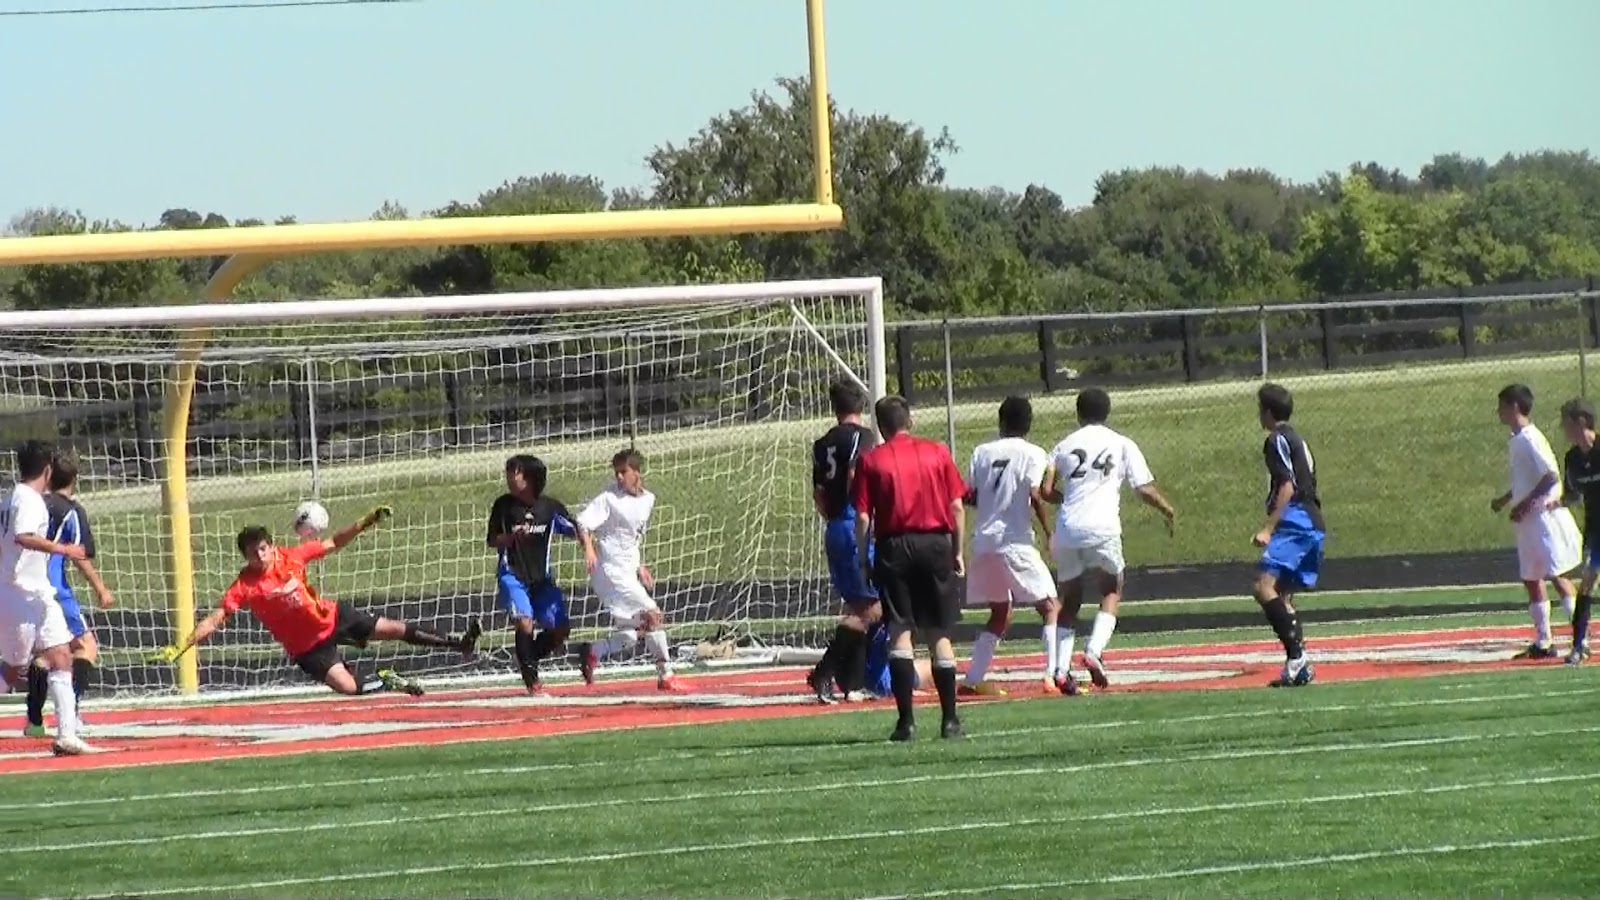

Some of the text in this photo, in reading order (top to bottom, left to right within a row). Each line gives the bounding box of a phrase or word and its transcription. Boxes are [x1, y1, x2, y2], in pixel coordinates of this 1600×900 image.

[826, 446, 837, 479] 5
[992, 459, 1011, 489] 7
[1070, 448, 1115, 478] 24
